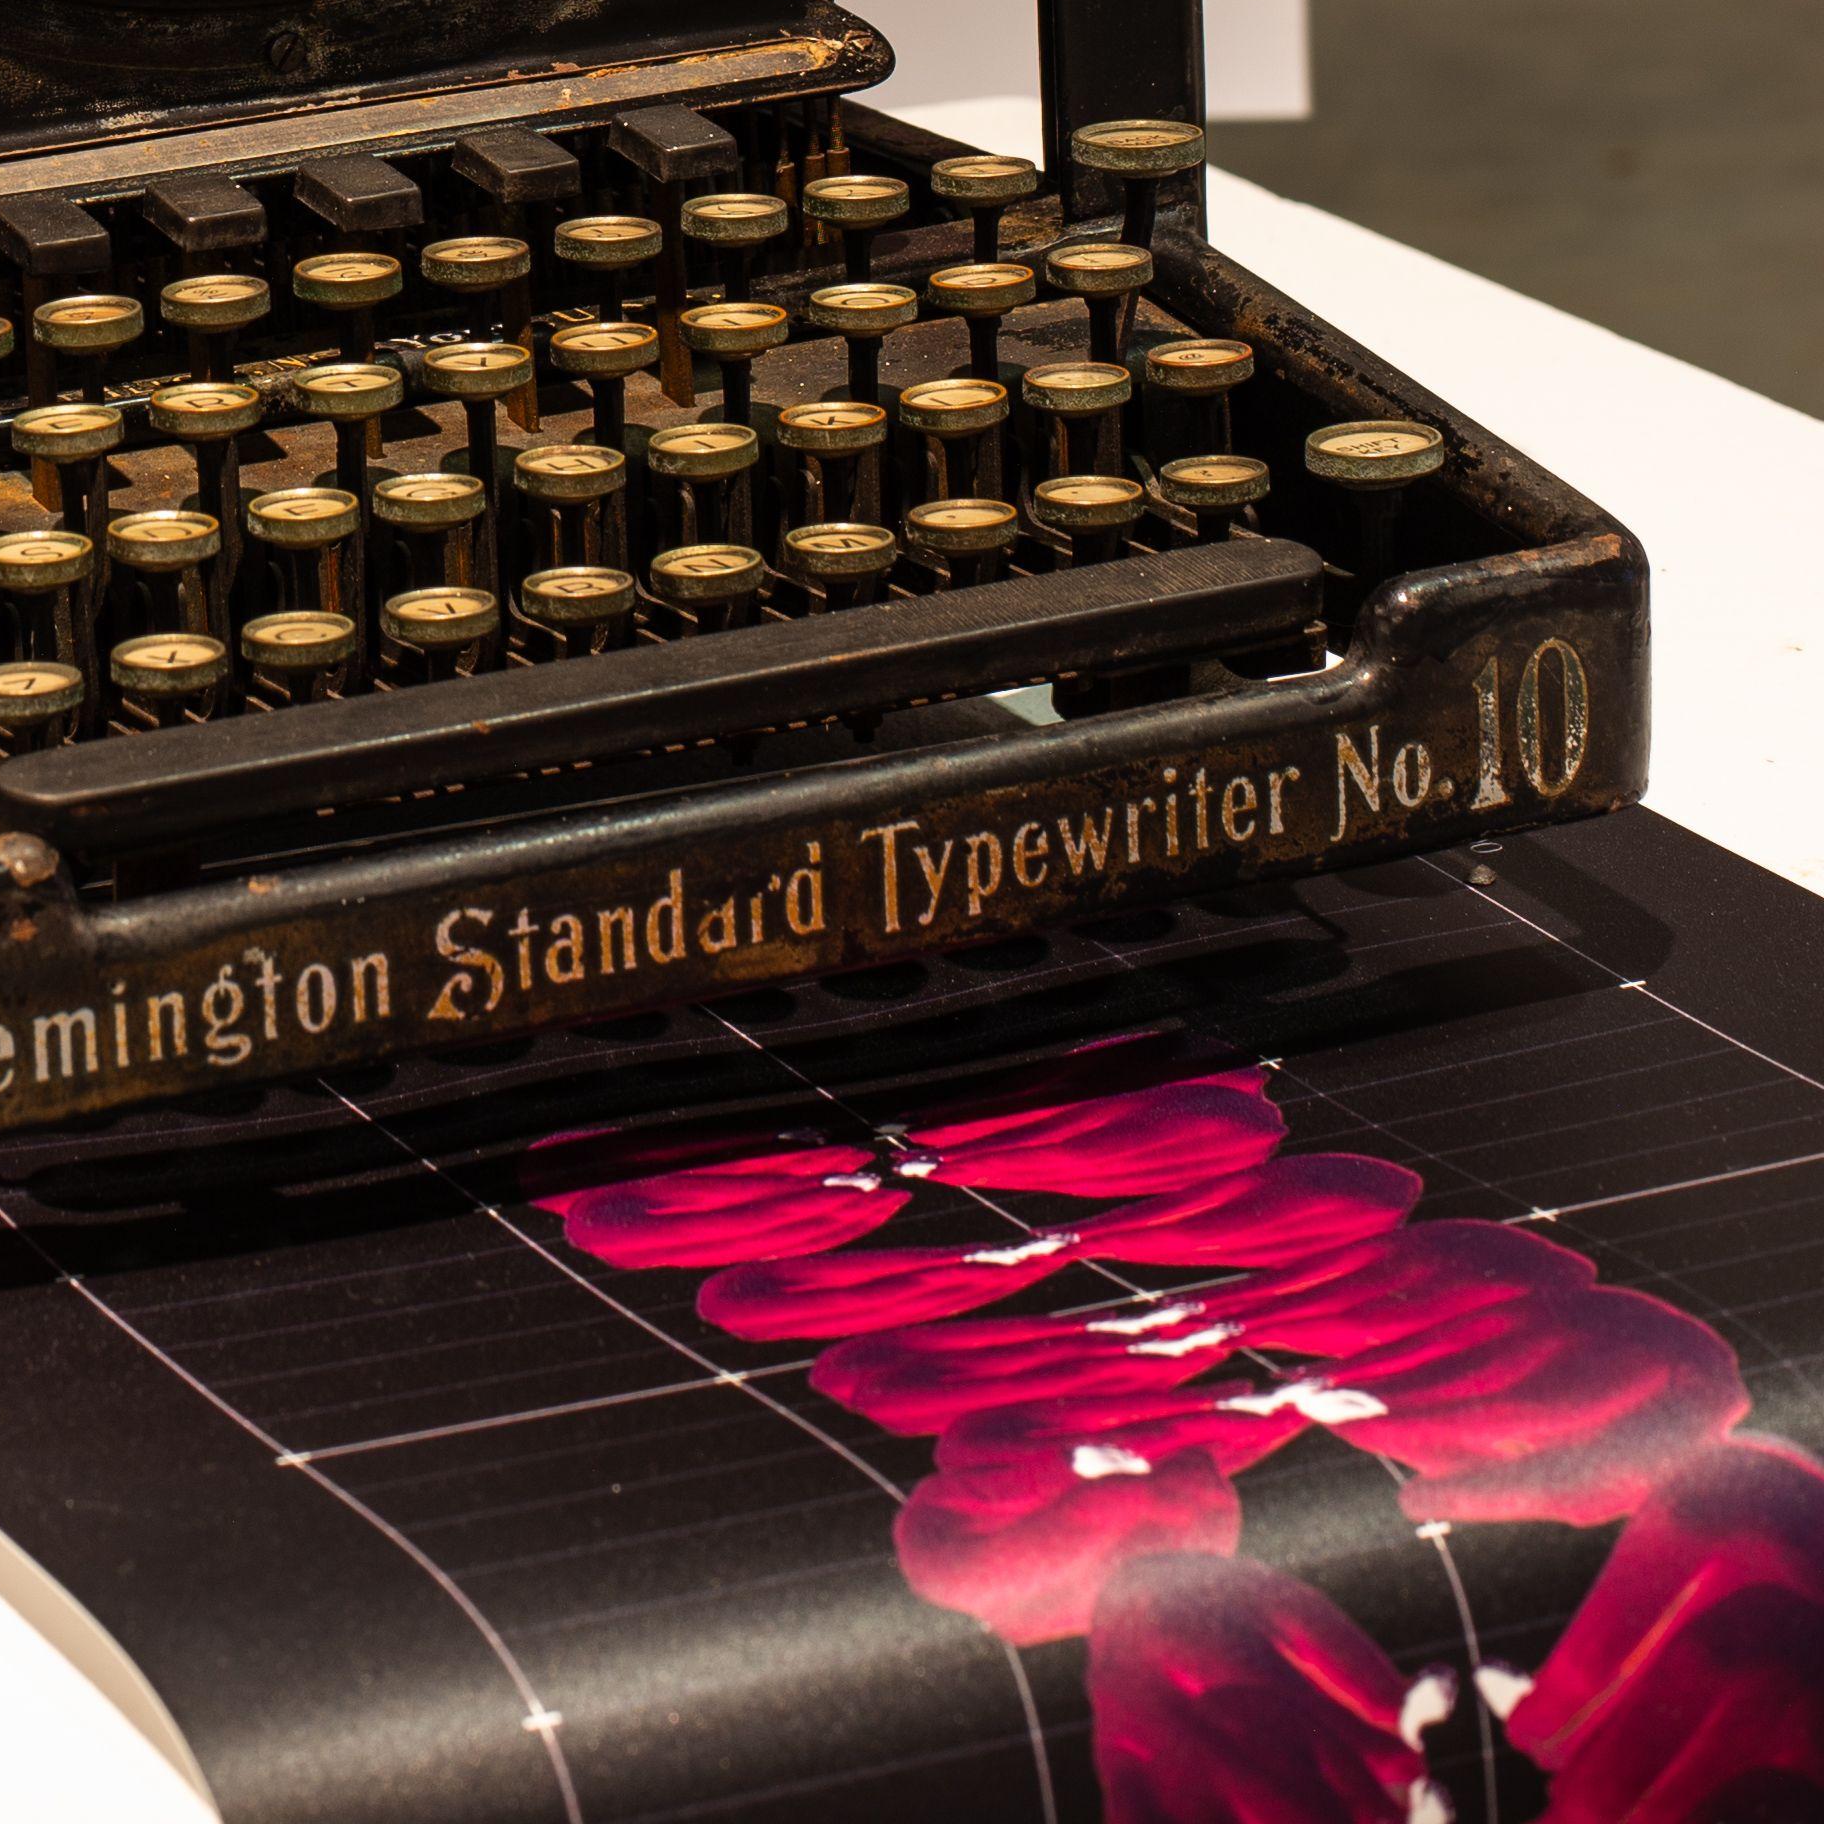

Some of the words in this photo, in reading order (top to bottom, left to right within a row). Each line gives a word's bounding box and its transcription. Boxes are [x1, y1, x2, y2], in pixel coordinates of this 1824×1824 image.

[19, 545, 63, 560] S
[145, 650, 191, 664] X
[426, 841, 826, 1021] Standard
[861, 766, 1301, 934] Typewriter
[1330, 725, 1456, 842] No.
[1470, 637, 1590, 811] 10
